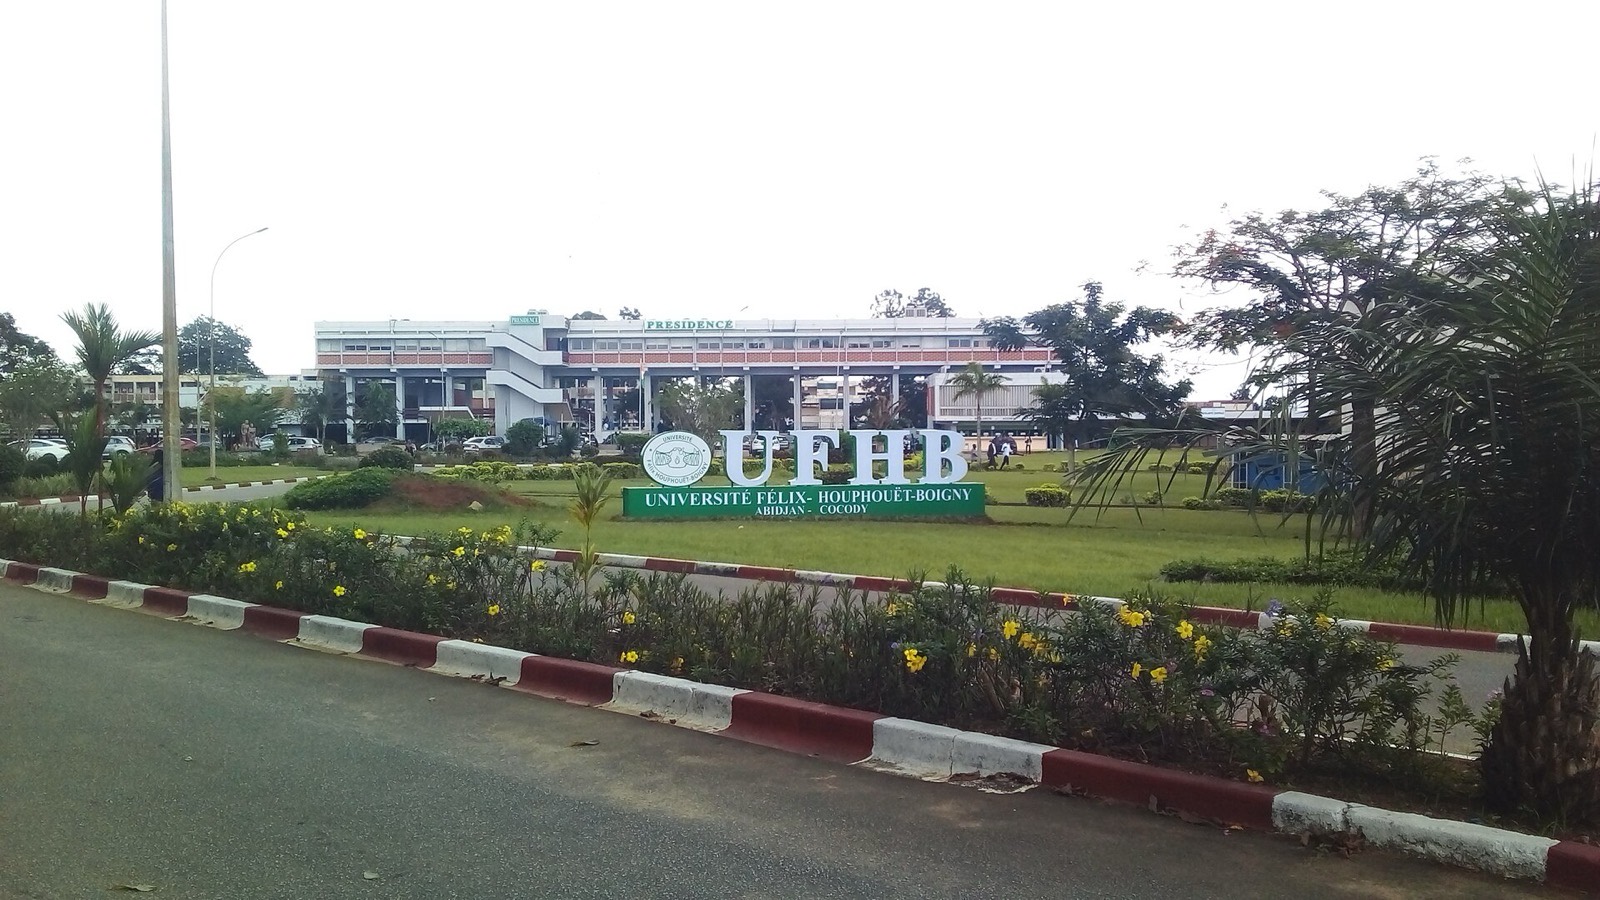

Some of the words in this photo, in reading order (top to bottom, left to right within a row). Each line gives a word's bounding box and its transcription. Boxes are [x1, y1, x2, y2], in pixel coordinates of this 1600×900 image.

[717, 429, 969, 486] UFHB
[645, 489, 752, 507] UNIVERSITÉ
[818, 487, 972, 504] HOUPHOUËT-BOIGNY
[755, 505, 805, 516] ABIDJAN
[819, 504, 869, 515] COCODY
